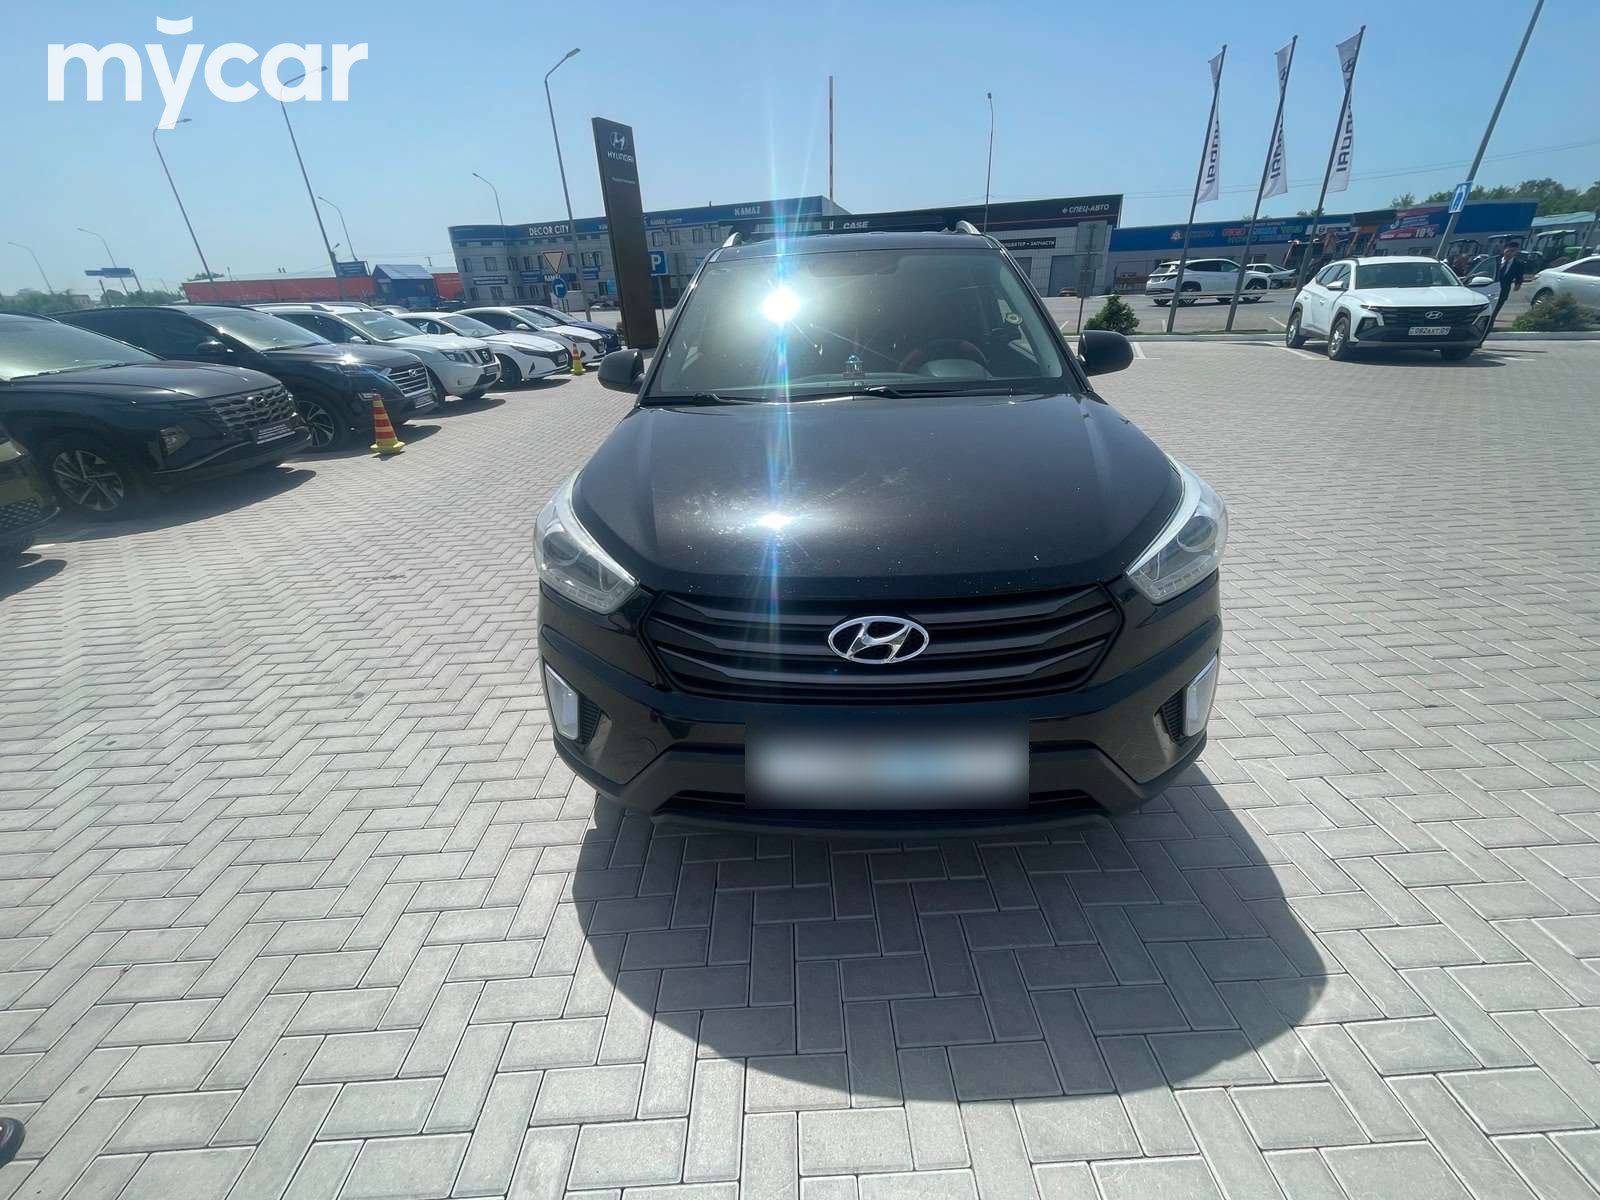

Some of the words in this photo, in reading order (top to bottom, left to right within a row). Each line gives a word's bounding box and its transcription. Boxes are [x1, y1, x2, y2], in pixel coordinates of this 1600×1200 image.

[528, 225, 553, 237] DECOR
[554, 224, 570, 235] CITY
[843, 221, 868, 229] CASE
[650, 254, 662, 271] P
